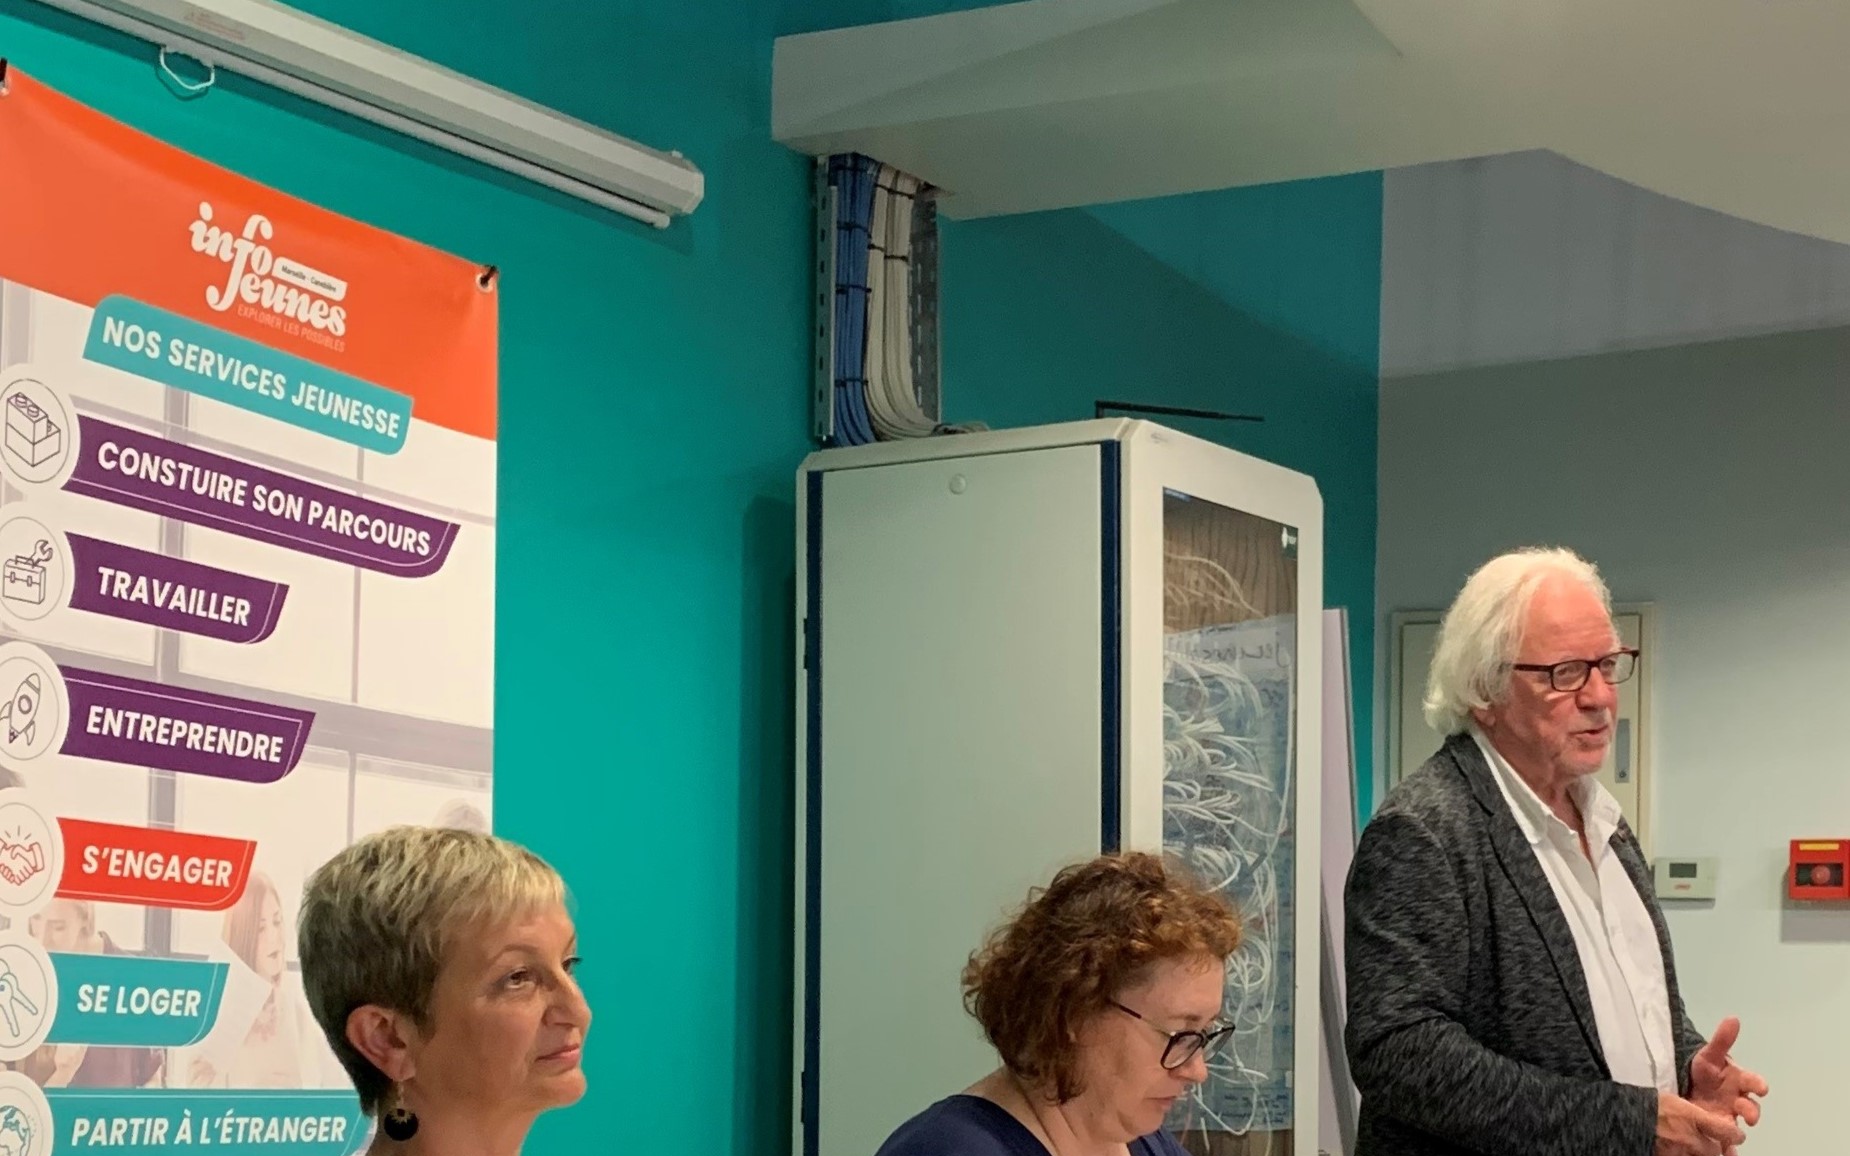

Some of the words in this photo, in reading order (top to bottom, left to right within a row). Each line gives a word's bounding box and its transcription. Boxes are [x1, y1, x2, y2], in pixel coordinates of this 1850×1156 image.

[237, 304, 282, 331] EXPLORER
[283, 319, 300, 336] LES
[300, 324, 345, 352] POSSIBLES
[102, 316, 162, 359] NOS
[168, 338, 287, 400] SERVICES
[291, 381, 400, 439] JEUNESSE
[97, 441, 248, 507] CONSTUIRE
[252, 484, 303, 522] SON
[307, 501, 431, 556] PARCOURS
[98, 566, 250, 627] TRAVAILLER
[86, 705, 284, 764] ENTREPRENDRE
[81, 845, 233, 888] S'ENGAGER
[77, 984, 108, 1014] SE
[116, 985, 201, 1017] LOGER
[71, 1116, 169, 1147] PARTIR
[174, 1108, 193, 1145] À
[199, 1107, 347, 1145] L'ÉTRANGER
